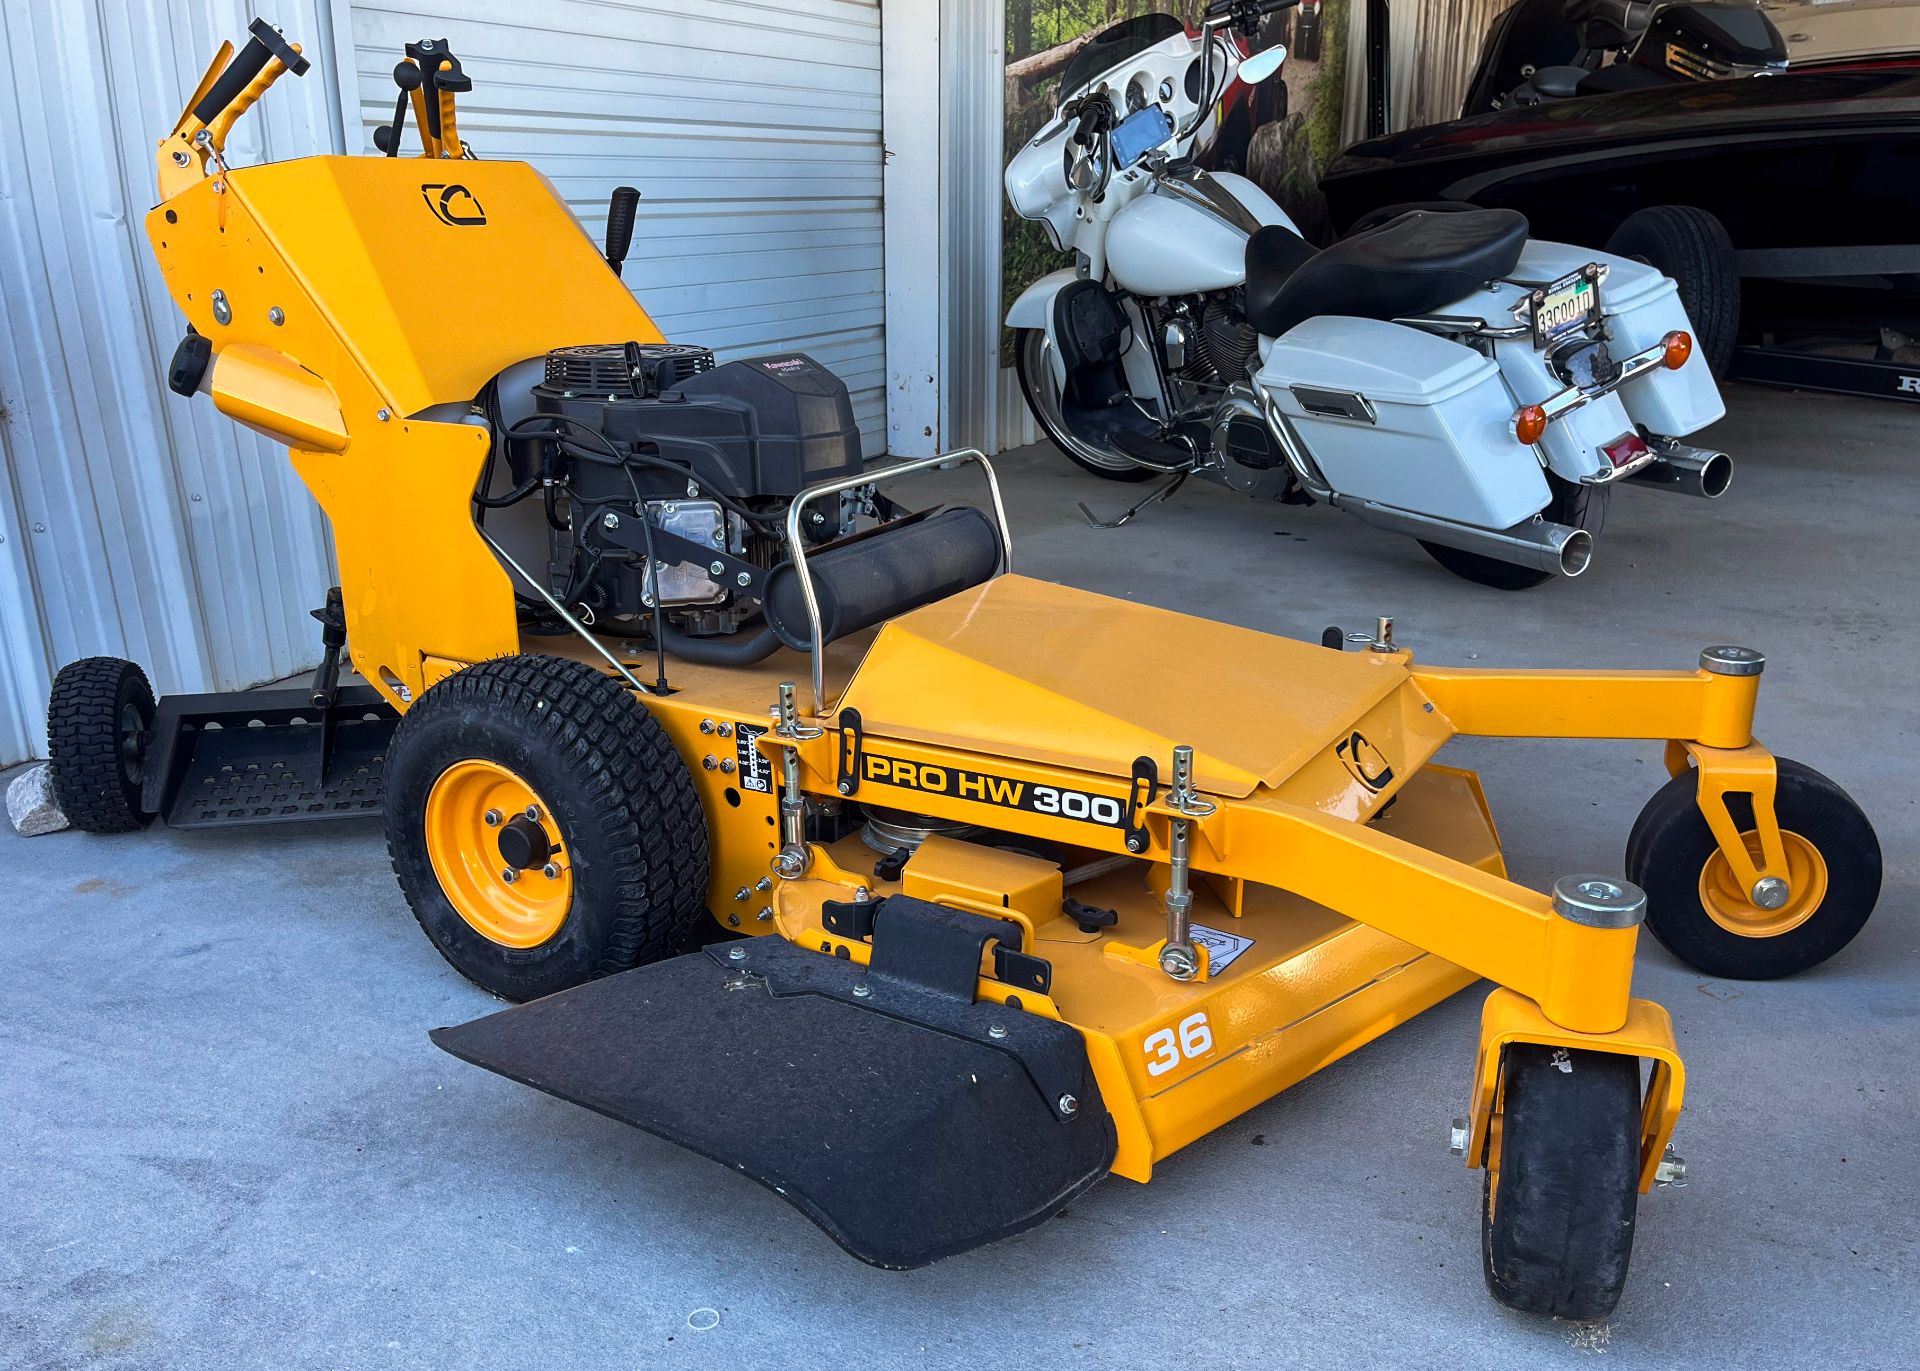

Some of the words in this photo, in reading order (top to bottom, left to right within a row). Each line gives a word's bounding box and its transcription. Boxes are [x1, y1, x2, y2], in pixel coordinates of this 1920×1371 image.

[867, 756, 947, 792] PRO
[958, 772, 1024, 806] HW
[1033, 786, 1119, 824] 300
[1144, 1012, 1212, 1076] 36
